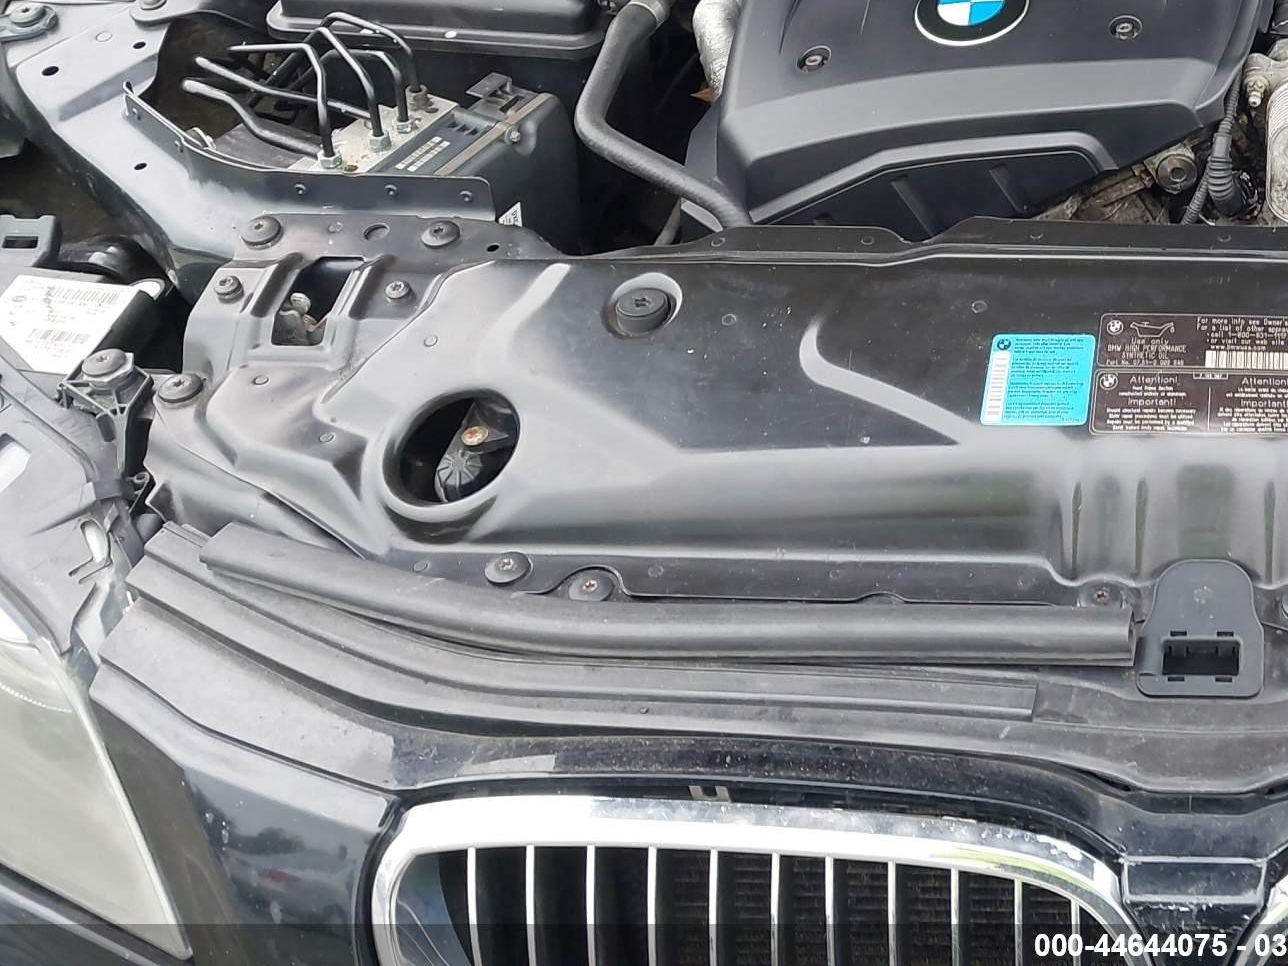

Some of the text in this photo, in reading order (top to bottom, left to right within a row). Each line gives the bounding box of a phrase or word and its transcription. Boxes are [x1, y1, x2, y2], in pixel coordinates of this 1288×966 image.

[1150, 337, 1169, 345] only
[1107, 344, 1187, 353] BMW HIGH PERFORMANCE
[1121, 351, 1168, 359] SYNTHETIC OIL
[1129, 375, 1178, 384] Attention!
[1241, 377, 1288, 386] Attention!
[1127, 398, 1176, 407] Important!
[1241, 399, 1288, 408] Important!
